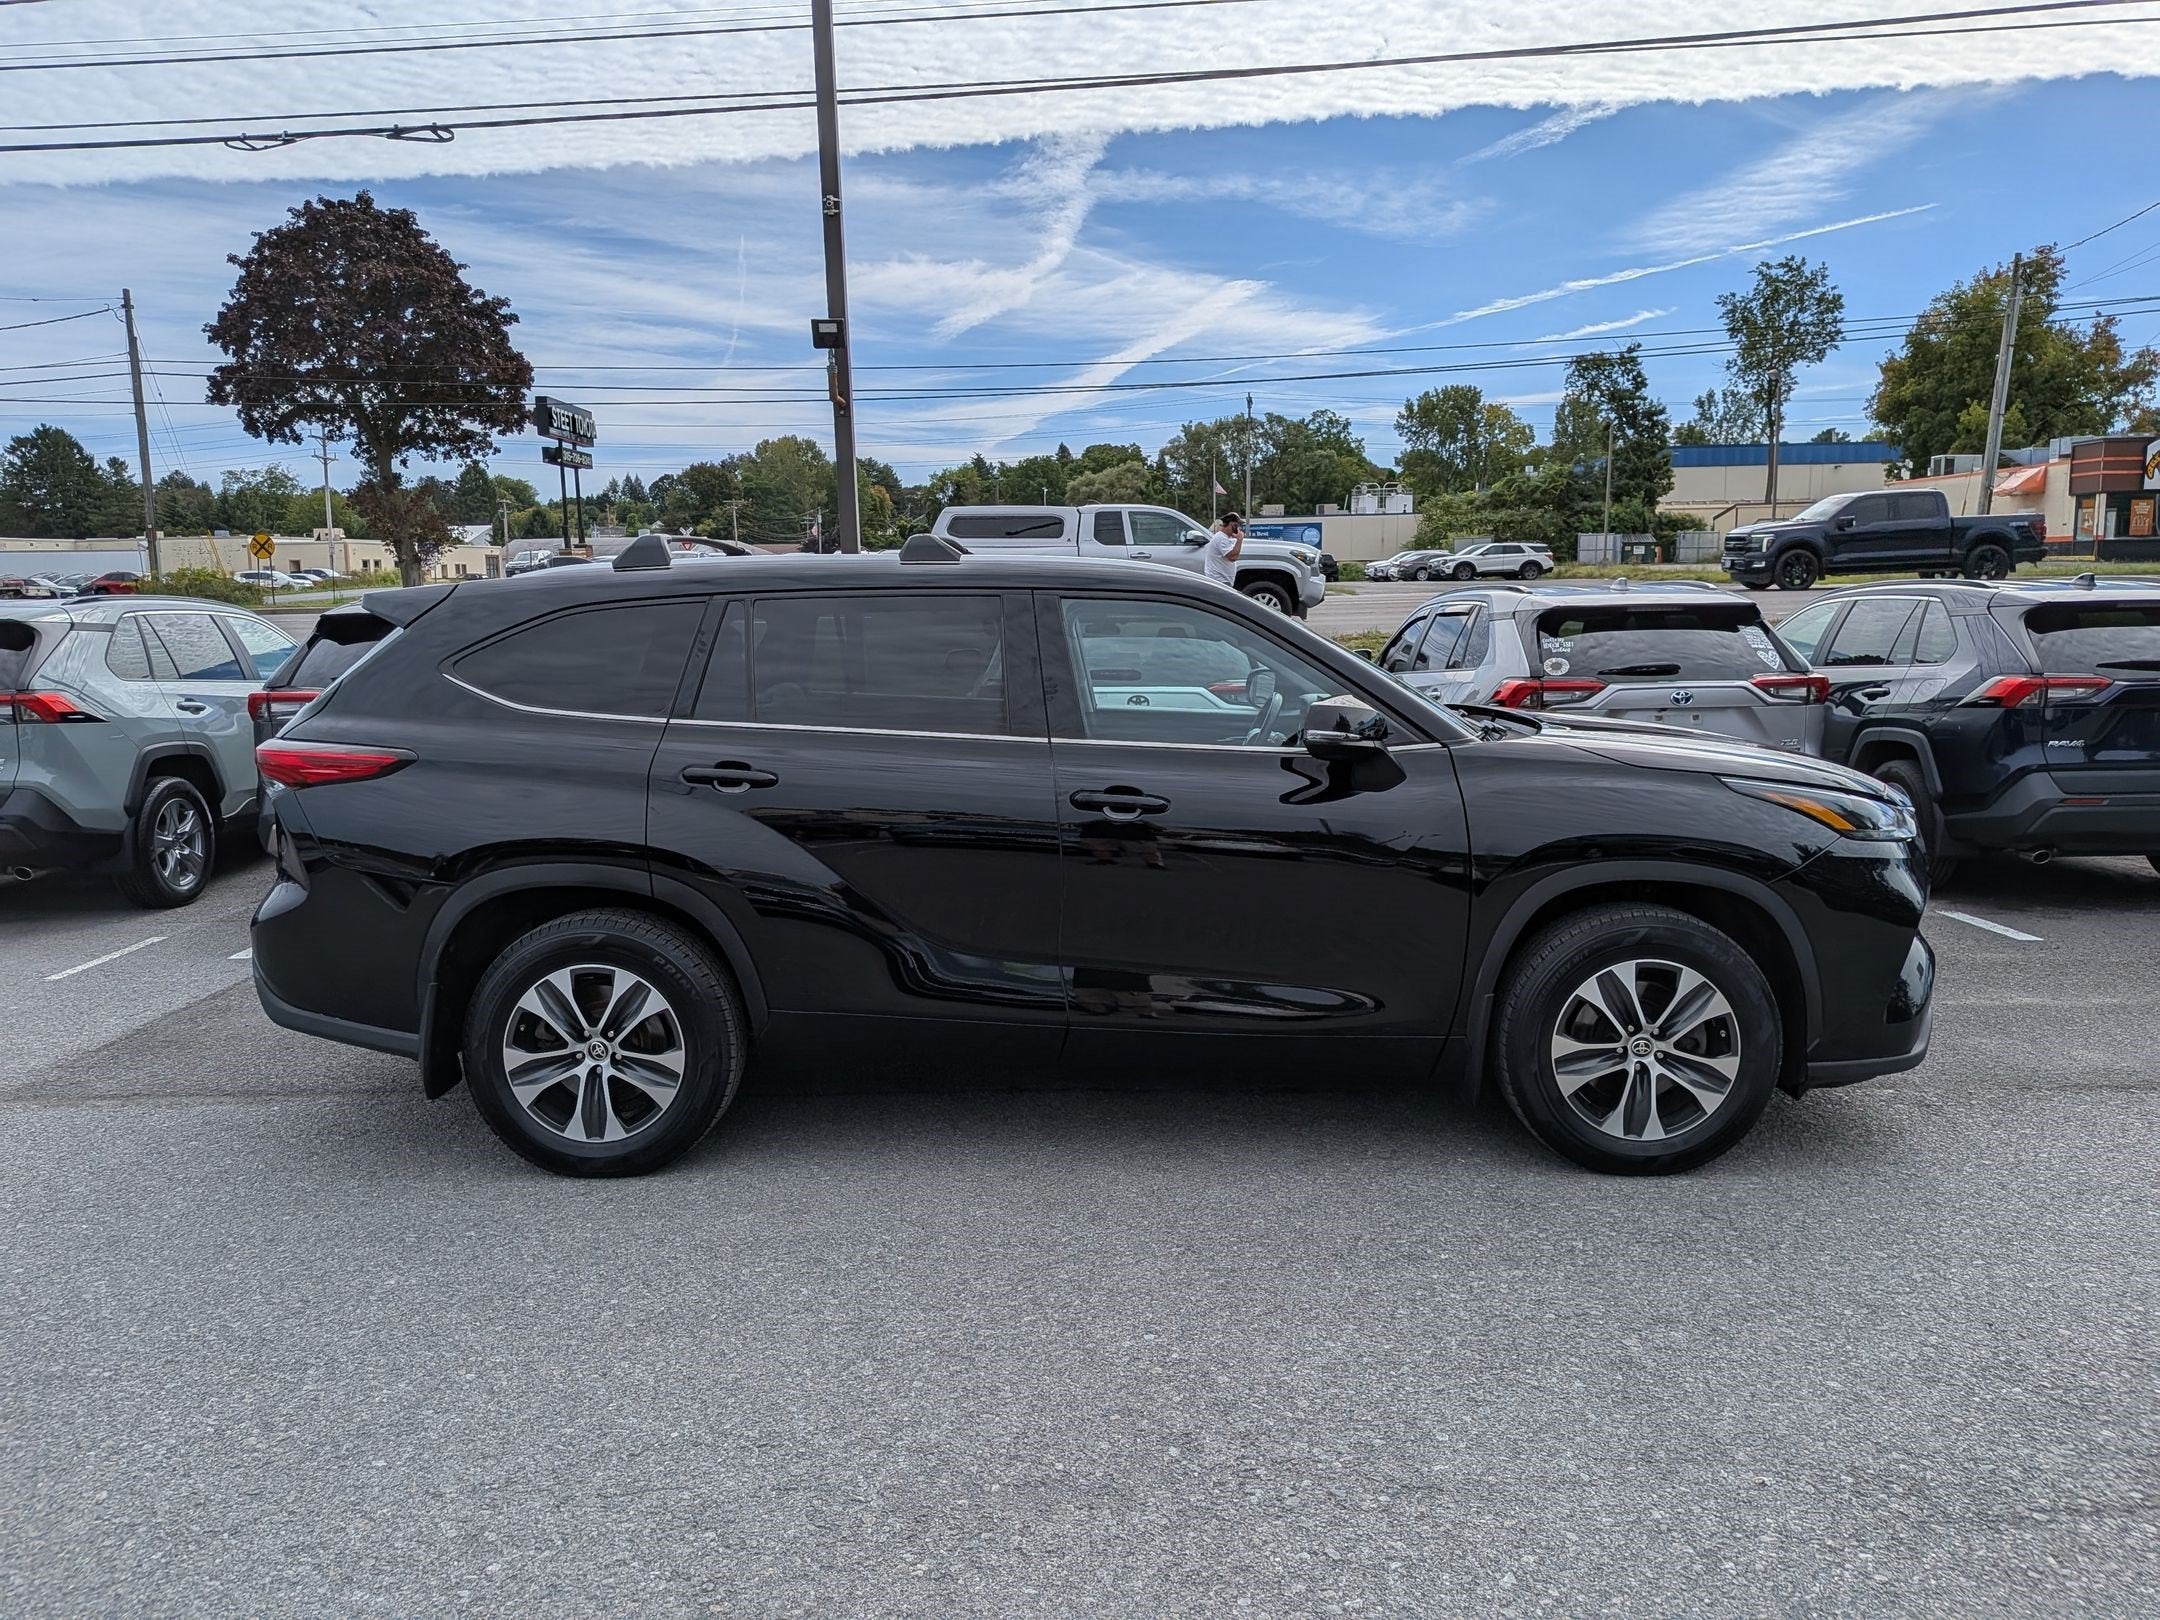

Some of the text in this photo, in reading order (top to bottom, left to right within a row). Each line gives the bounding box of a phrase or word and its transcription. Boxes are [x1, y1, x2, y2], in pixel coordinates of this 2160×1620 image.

[551, 406, 598, 439] STEET TOYOTA
[267, 542, 273, 550] R
